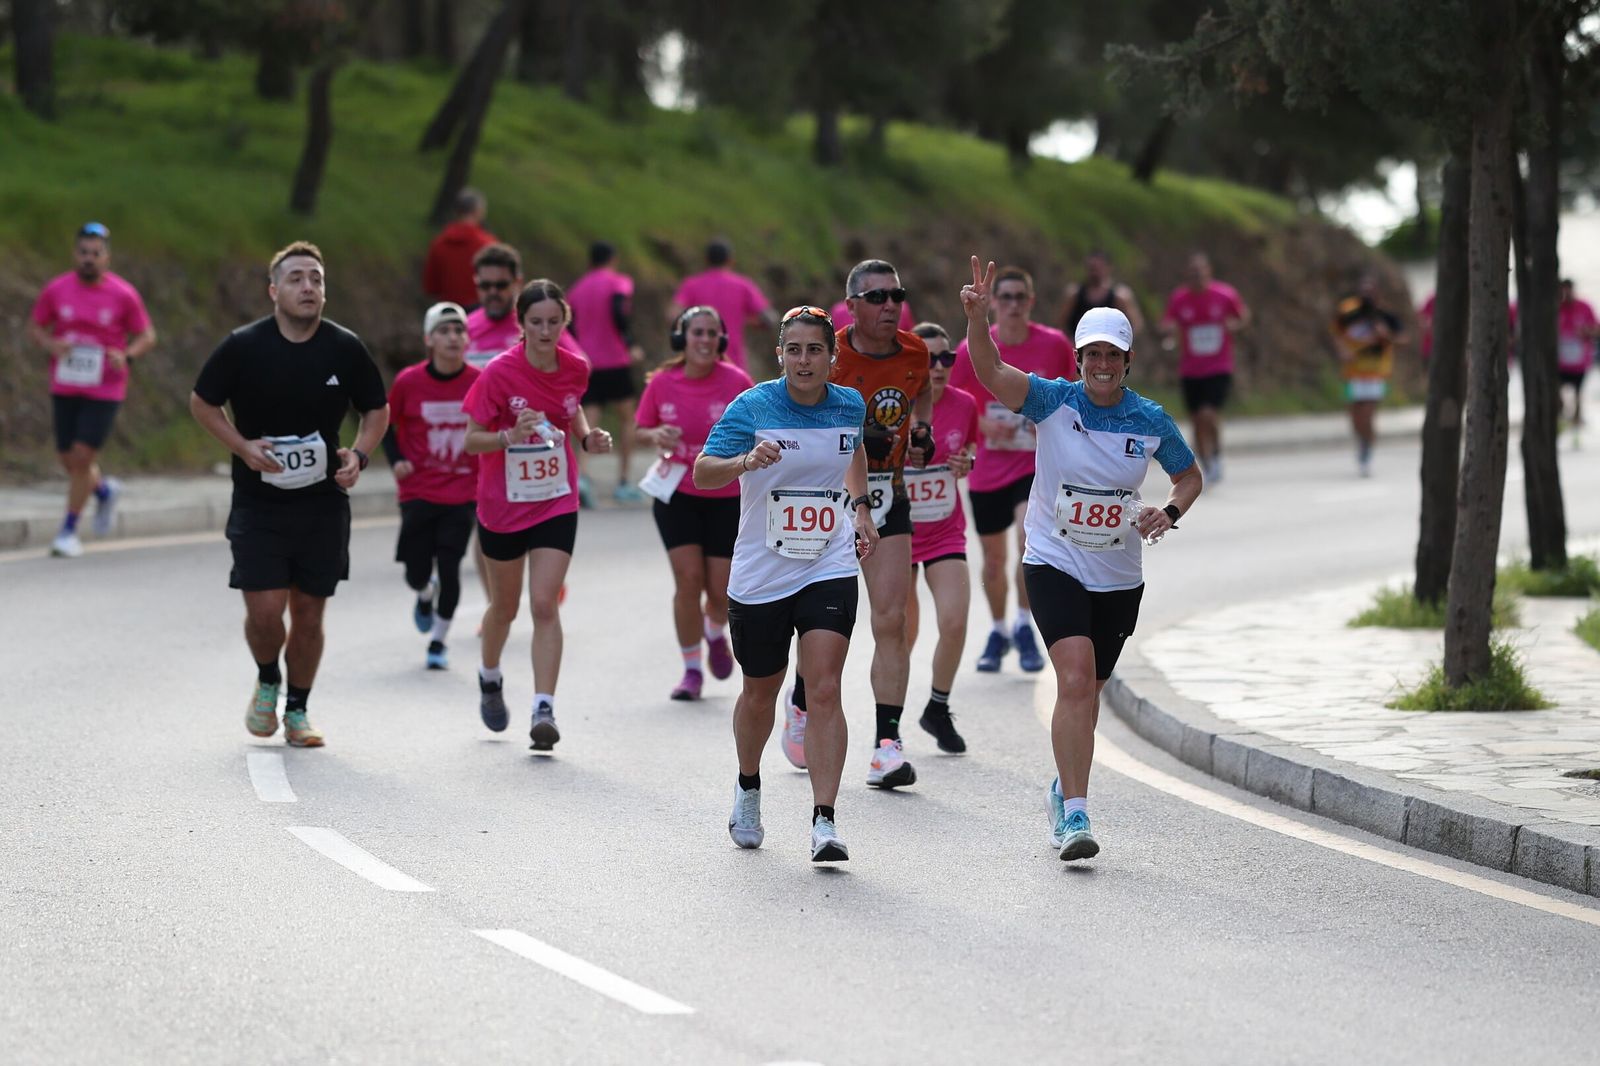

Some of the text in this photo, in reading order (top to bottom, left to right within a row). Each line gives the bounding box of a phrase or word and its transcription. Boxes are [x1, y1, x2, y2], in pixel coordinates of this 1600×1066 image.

[518, 456, 560, 481] 138
[907, 479, 947, 503] 152
[782, 505, 836, 533] 190
[1068, 501, 1123, 528] 188
